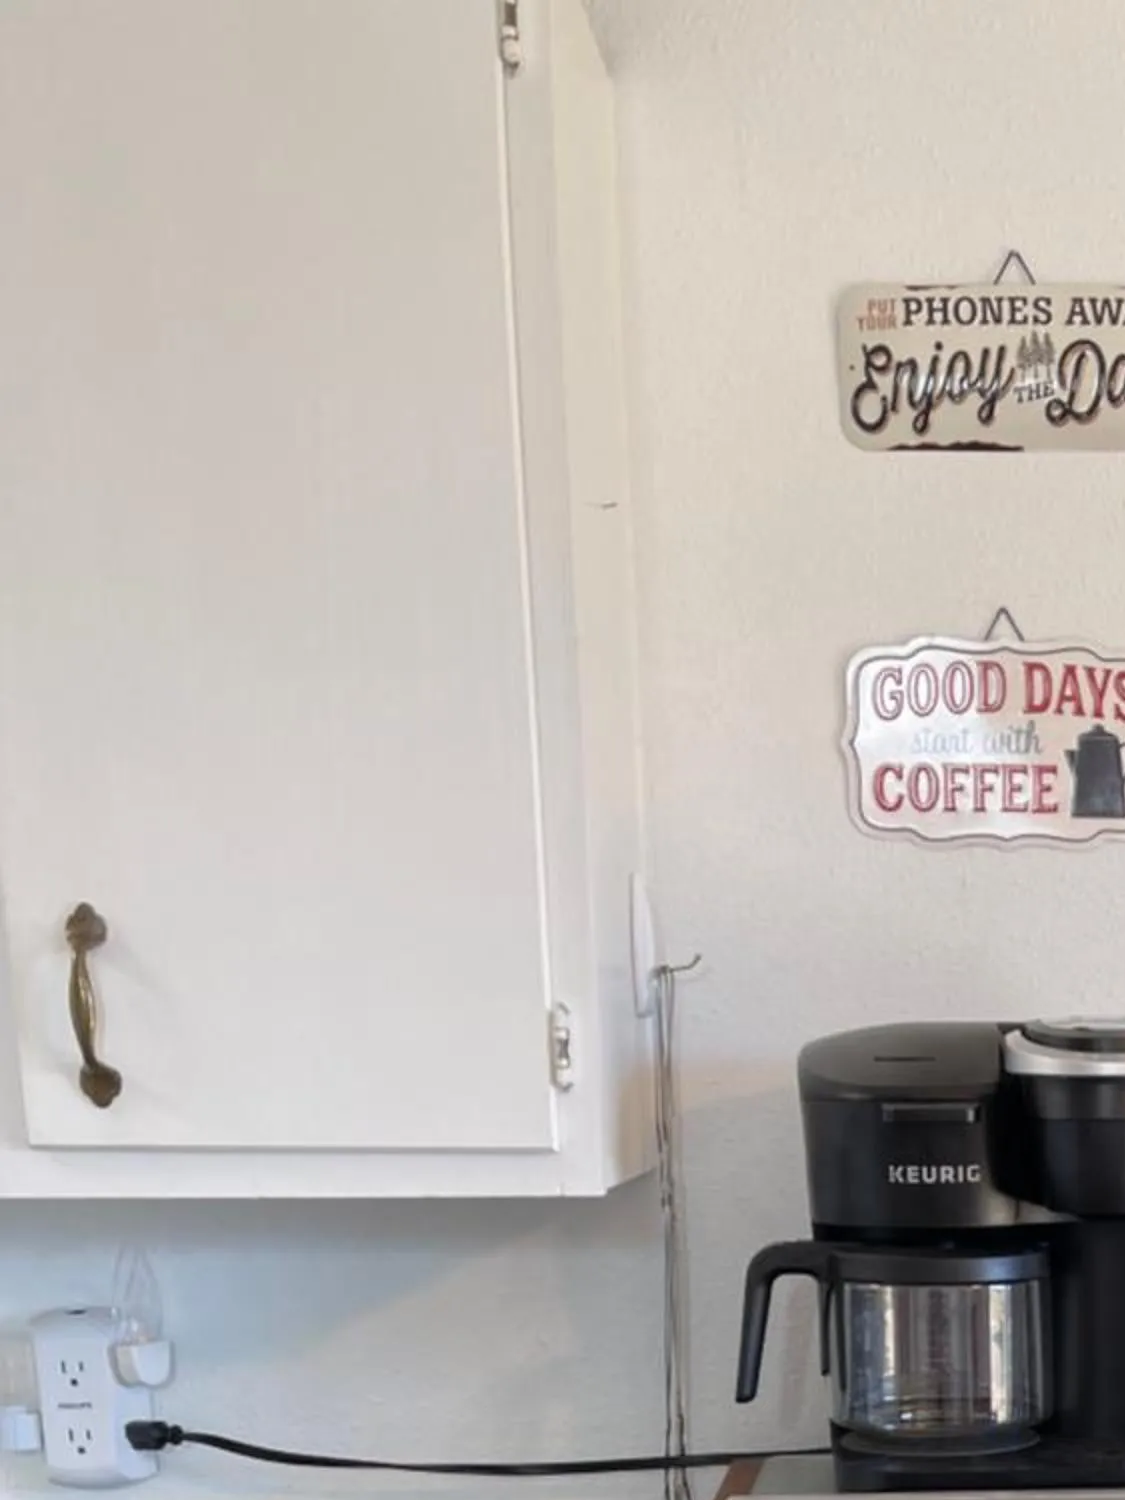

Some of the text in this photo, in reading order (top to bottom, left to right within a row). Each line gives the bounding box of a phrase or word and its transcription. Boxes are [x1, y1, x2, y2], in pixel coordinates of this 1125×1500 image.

[902, 296, 1053, 326] PHONES
[851, 341, 1015, 435] Enjoy
[1014, 384, 1055, 404] THE
[872, 660, 1007, 721] GOOD
[911, 719, 1044, 755] start with
[872, 763, 1060, 814] COFFEE
[888, 1164, 981, 1184] KEURIG
